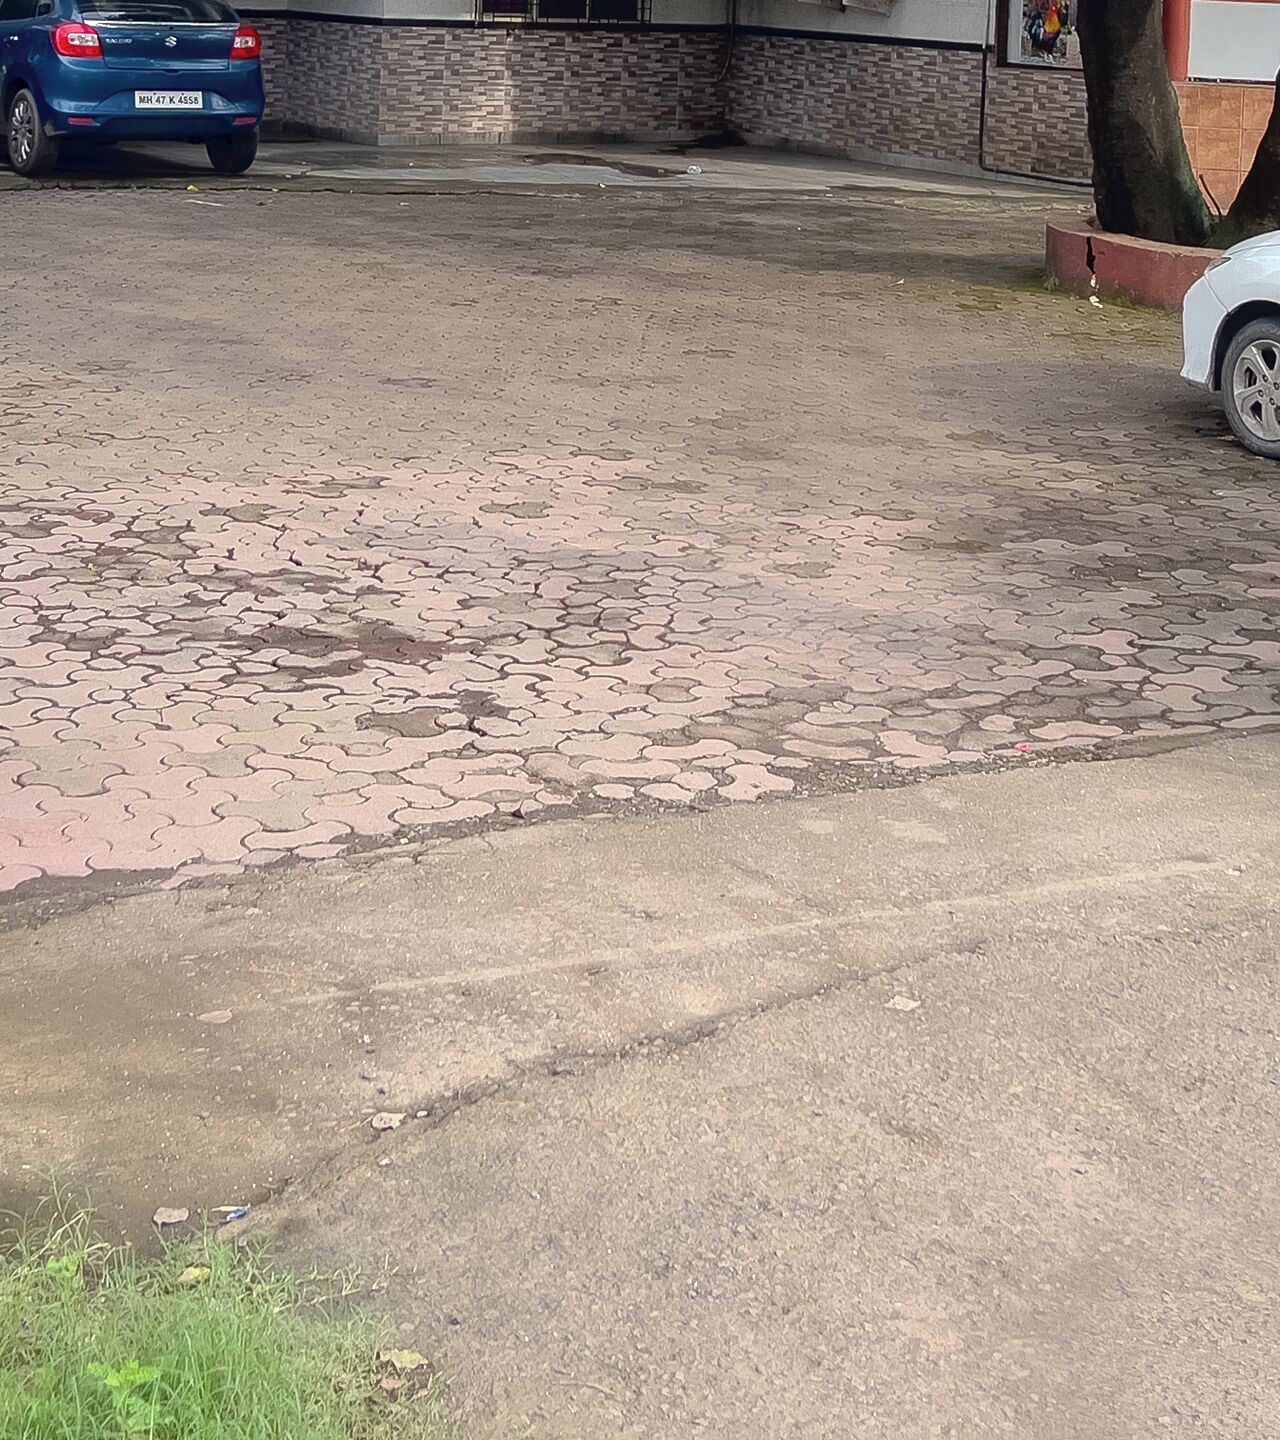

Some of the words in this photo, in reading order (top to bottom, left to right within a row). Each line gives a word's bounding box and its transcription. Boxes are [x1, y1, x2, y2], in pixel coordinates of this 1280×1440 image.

[138, 95, 153, 105] MH
[155, 95, 166, 105] 47
[168, 95, 176, 105] K
